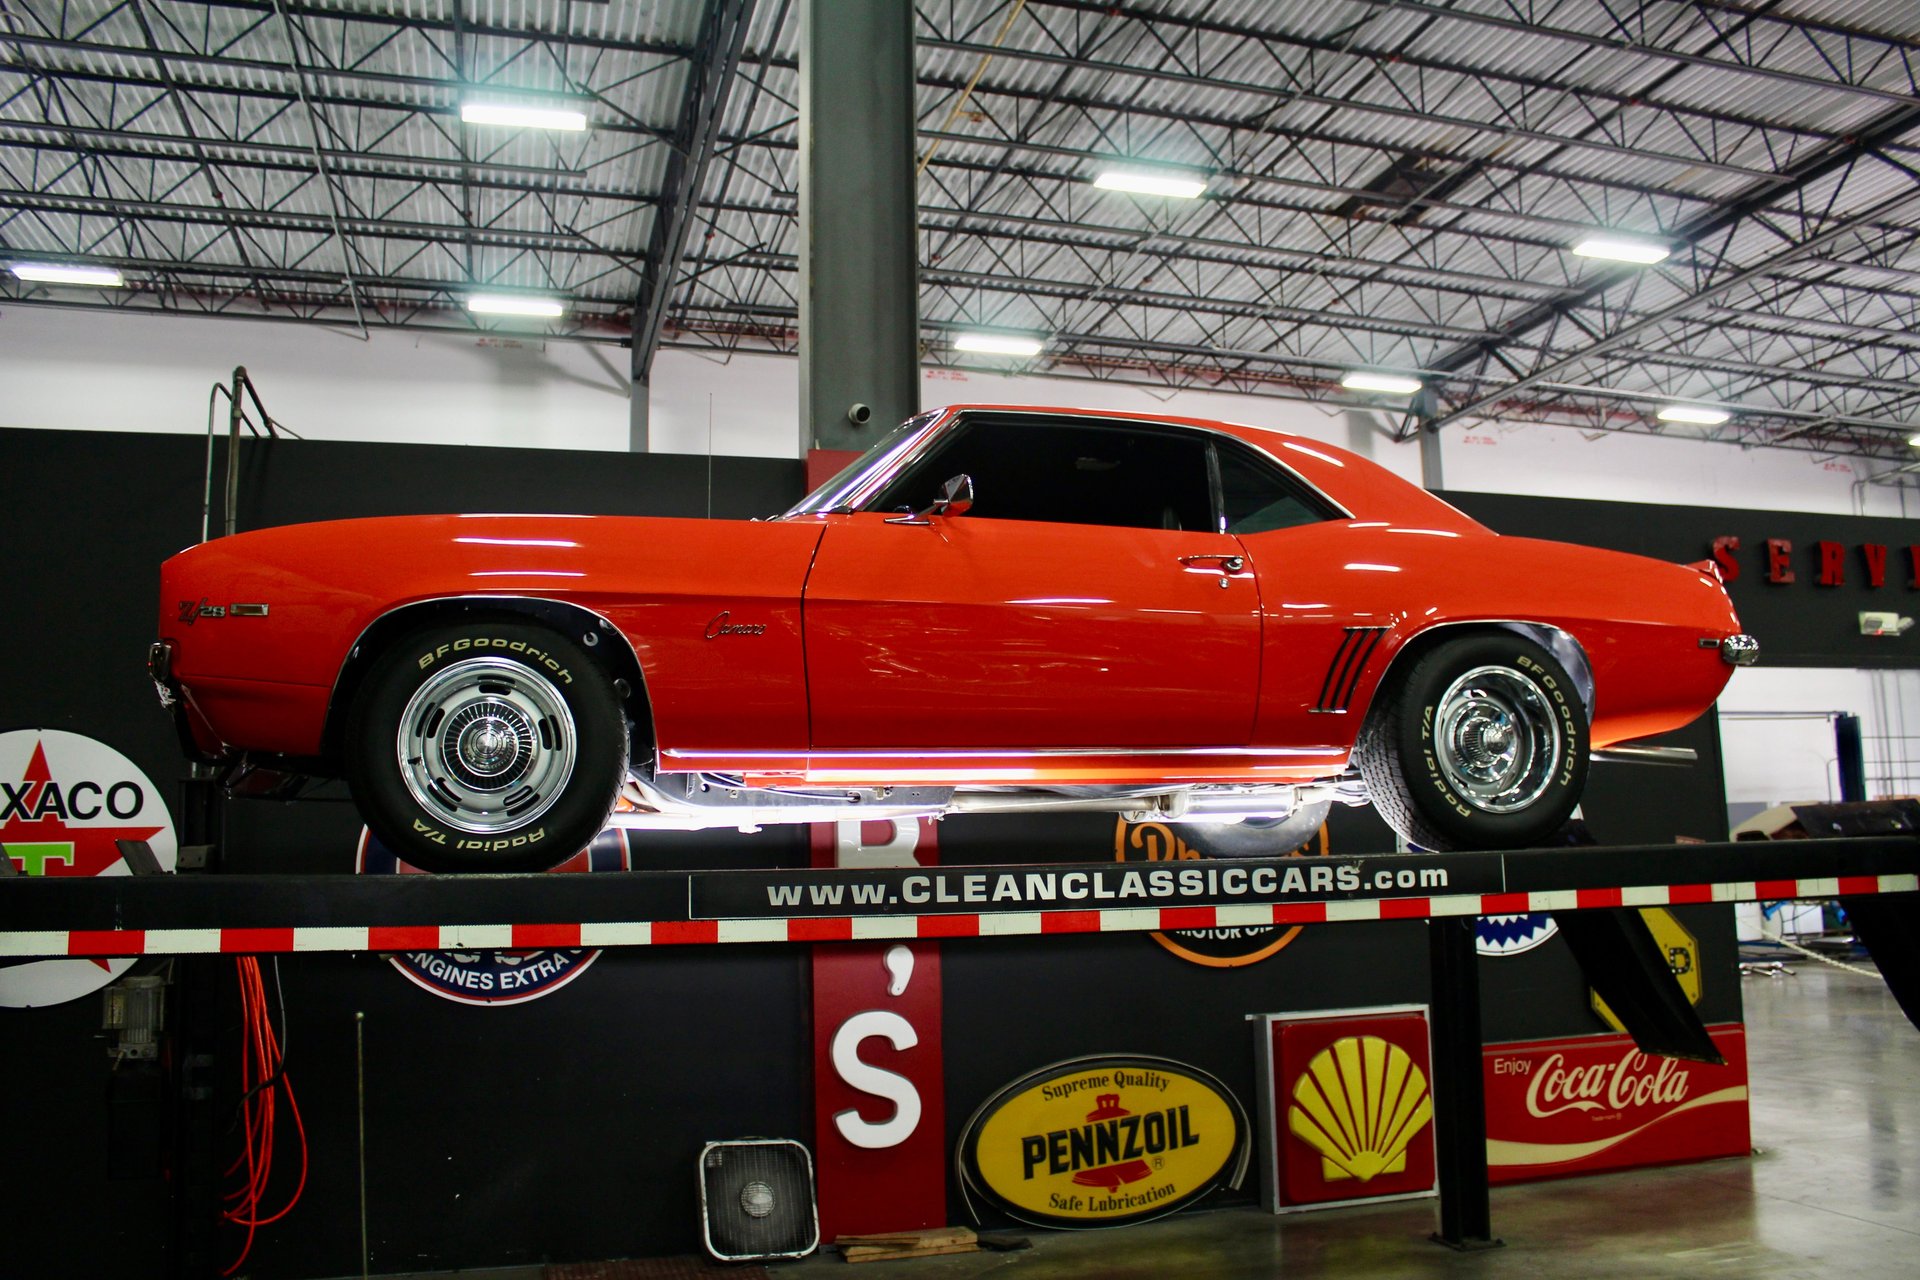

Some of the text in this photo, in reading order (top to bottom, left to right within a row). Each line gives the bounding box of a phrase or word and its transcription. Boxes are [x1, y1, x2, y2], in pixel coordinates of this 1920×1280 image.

[418, 637, 573, 685] BFGoodrich
[1516, 655, 1577, 787] BFGoodrich
[1422, 705, 1472, 818] Radial T/A
[413, 818, 545, 852] Radial T/A
[766, 865, 1449, 907] www.CLEANCLASSICCARS.com
[406, 952, 494, 990] NGINES
[500, 953, 570, 990] EXTRA
[1042, 1071, 1170, 1102] Supreme Quality
[1494, 1058, 1532, 1076] Enjoy
[1021, 1105, 1199, 1181] PENNZOIL
[1048, 1183, 1176, 1212] Safe Lubrication
